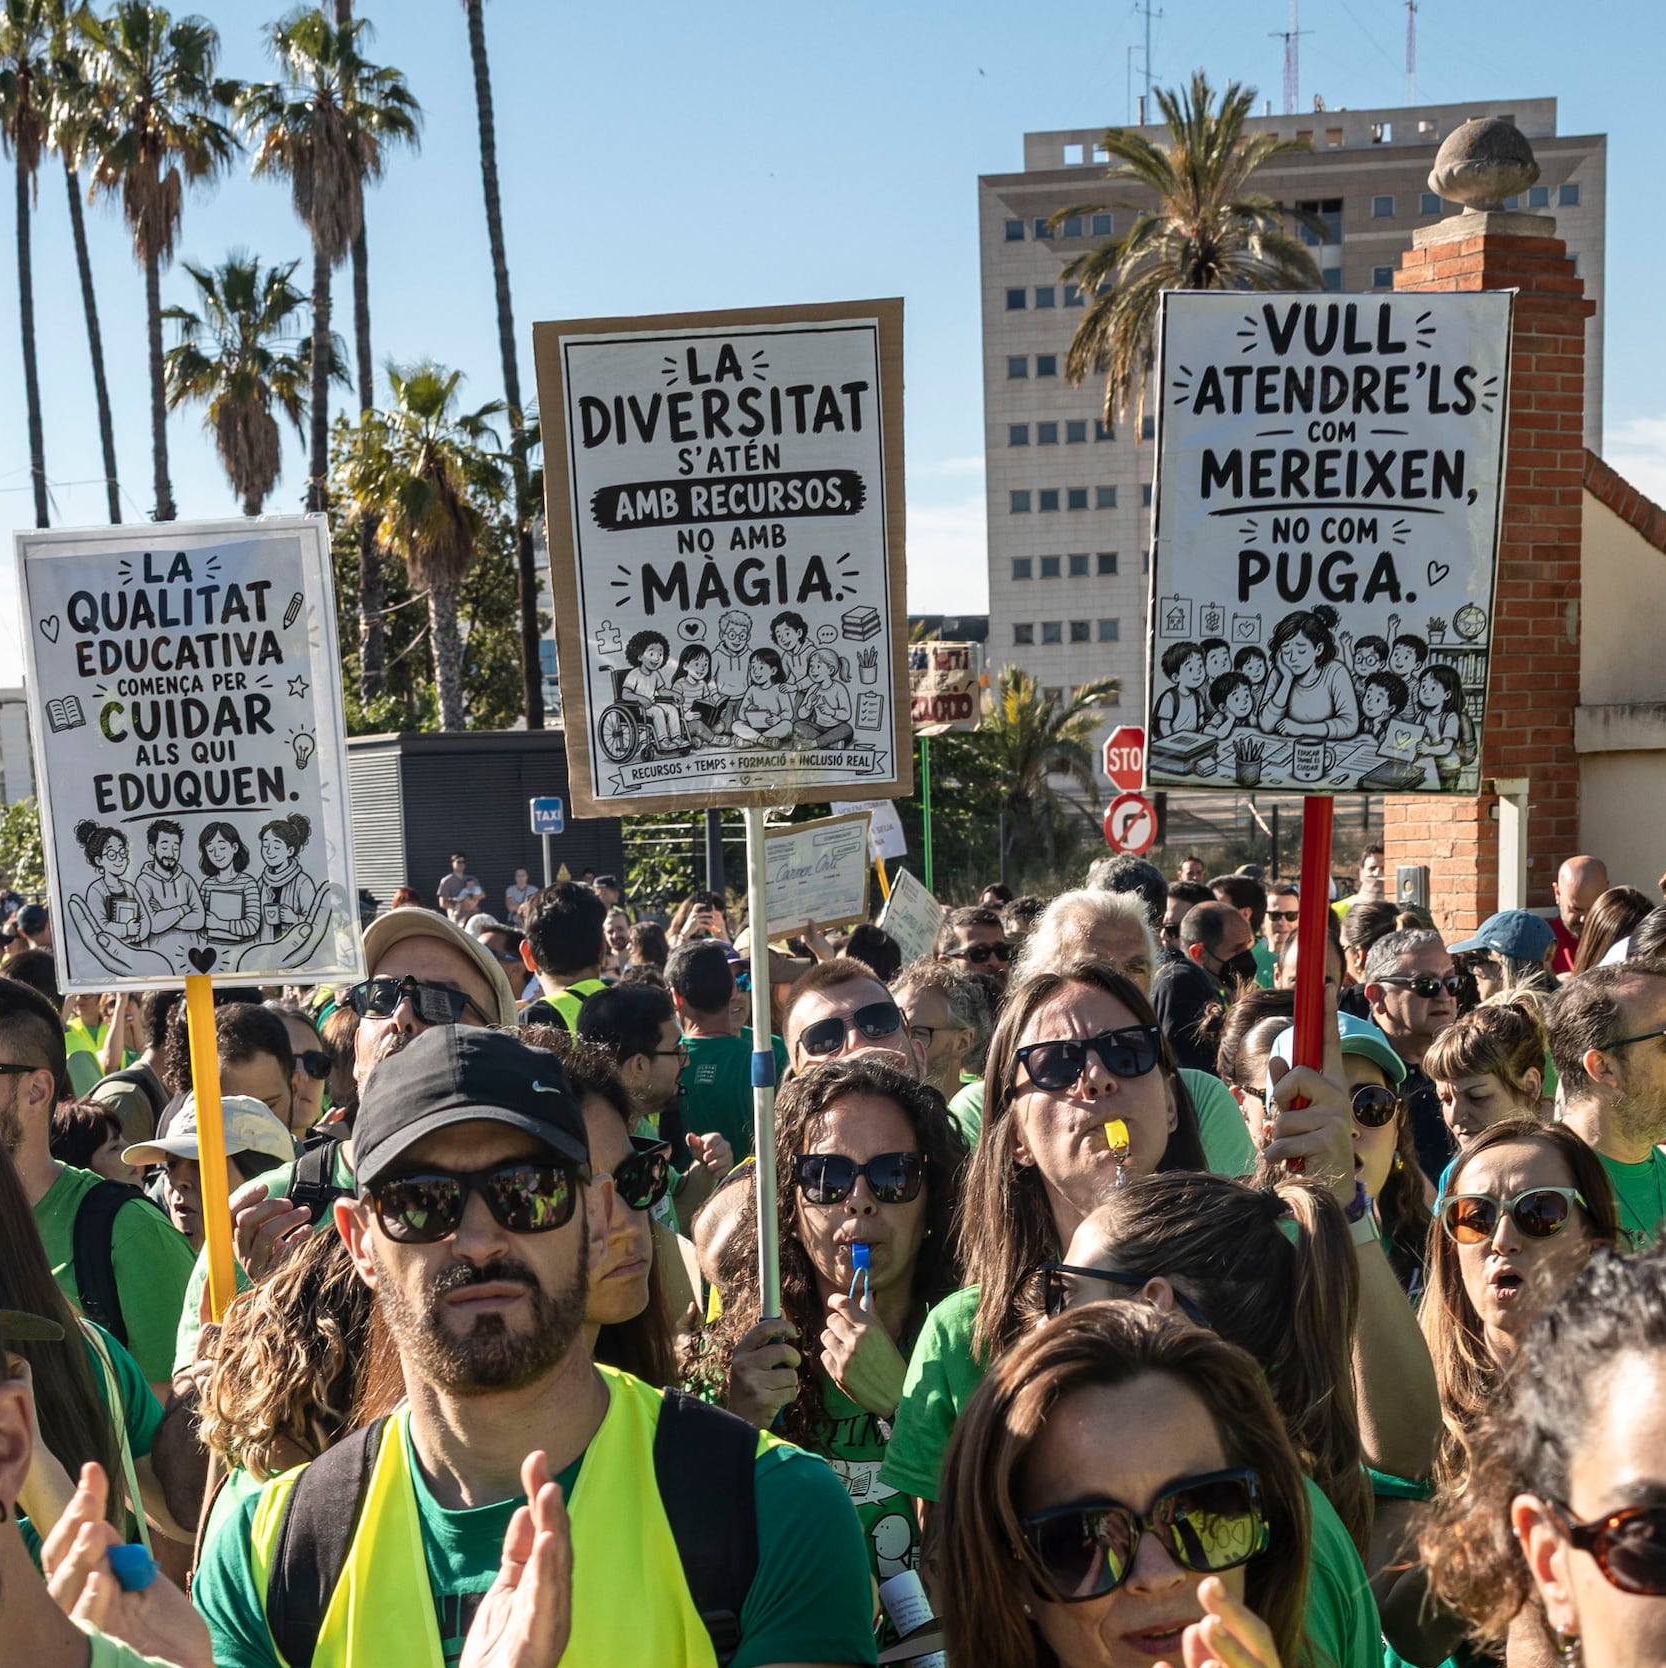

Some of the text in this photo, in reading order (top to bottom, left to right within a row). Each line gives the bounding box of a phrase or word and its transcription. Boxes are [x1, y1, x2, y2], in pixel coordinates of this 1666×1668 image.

[1262, 302, 1406, 356] VULL
[686, 343, 743, 385] LA
[1192, 362, 1478, 415] ATENDRE'LS
[579, 381, 869, 448] DIVERSITAT
[1308, 421, 1355, 443] COM
[678, 439, 780, 475] S'ATÉN
[1201, 449, 1478, 505] MEREIXEN,
[616, 477, 851, 522] AMB RECURSOS,
[677, 524, 787, 554] NO AMB
[1272, 517, 1378, 543] NO COM
[144, 552, 193, 583] LA
[642, 554, 844, 616] MÀGIA.
[1238, 550, 1417, 603] PUGA.
[68, 580, 272, 635] QUALITAT
[75, 630, 284, 677] EDUCATIVA
[117, 672, 247, 697] COMENÇA PER
[100, 693, 275, 743] CUIDAR
[135, 740, 235, 766] ALS QUI
[632, 762, 683, 781] RECURSOS
[695, 758, 727, 772] TEMPS
[738, 754, 787, 769] FORMACIÓ
[799, 753, 843, 767] INCLUSIÓ
[846, 755, 871, 768] REAL
[1109, 746, 1142, 772] STO
[93, 766, 300, 814] EDUQUEN.
[535, 809, 561, 822] TAXI
